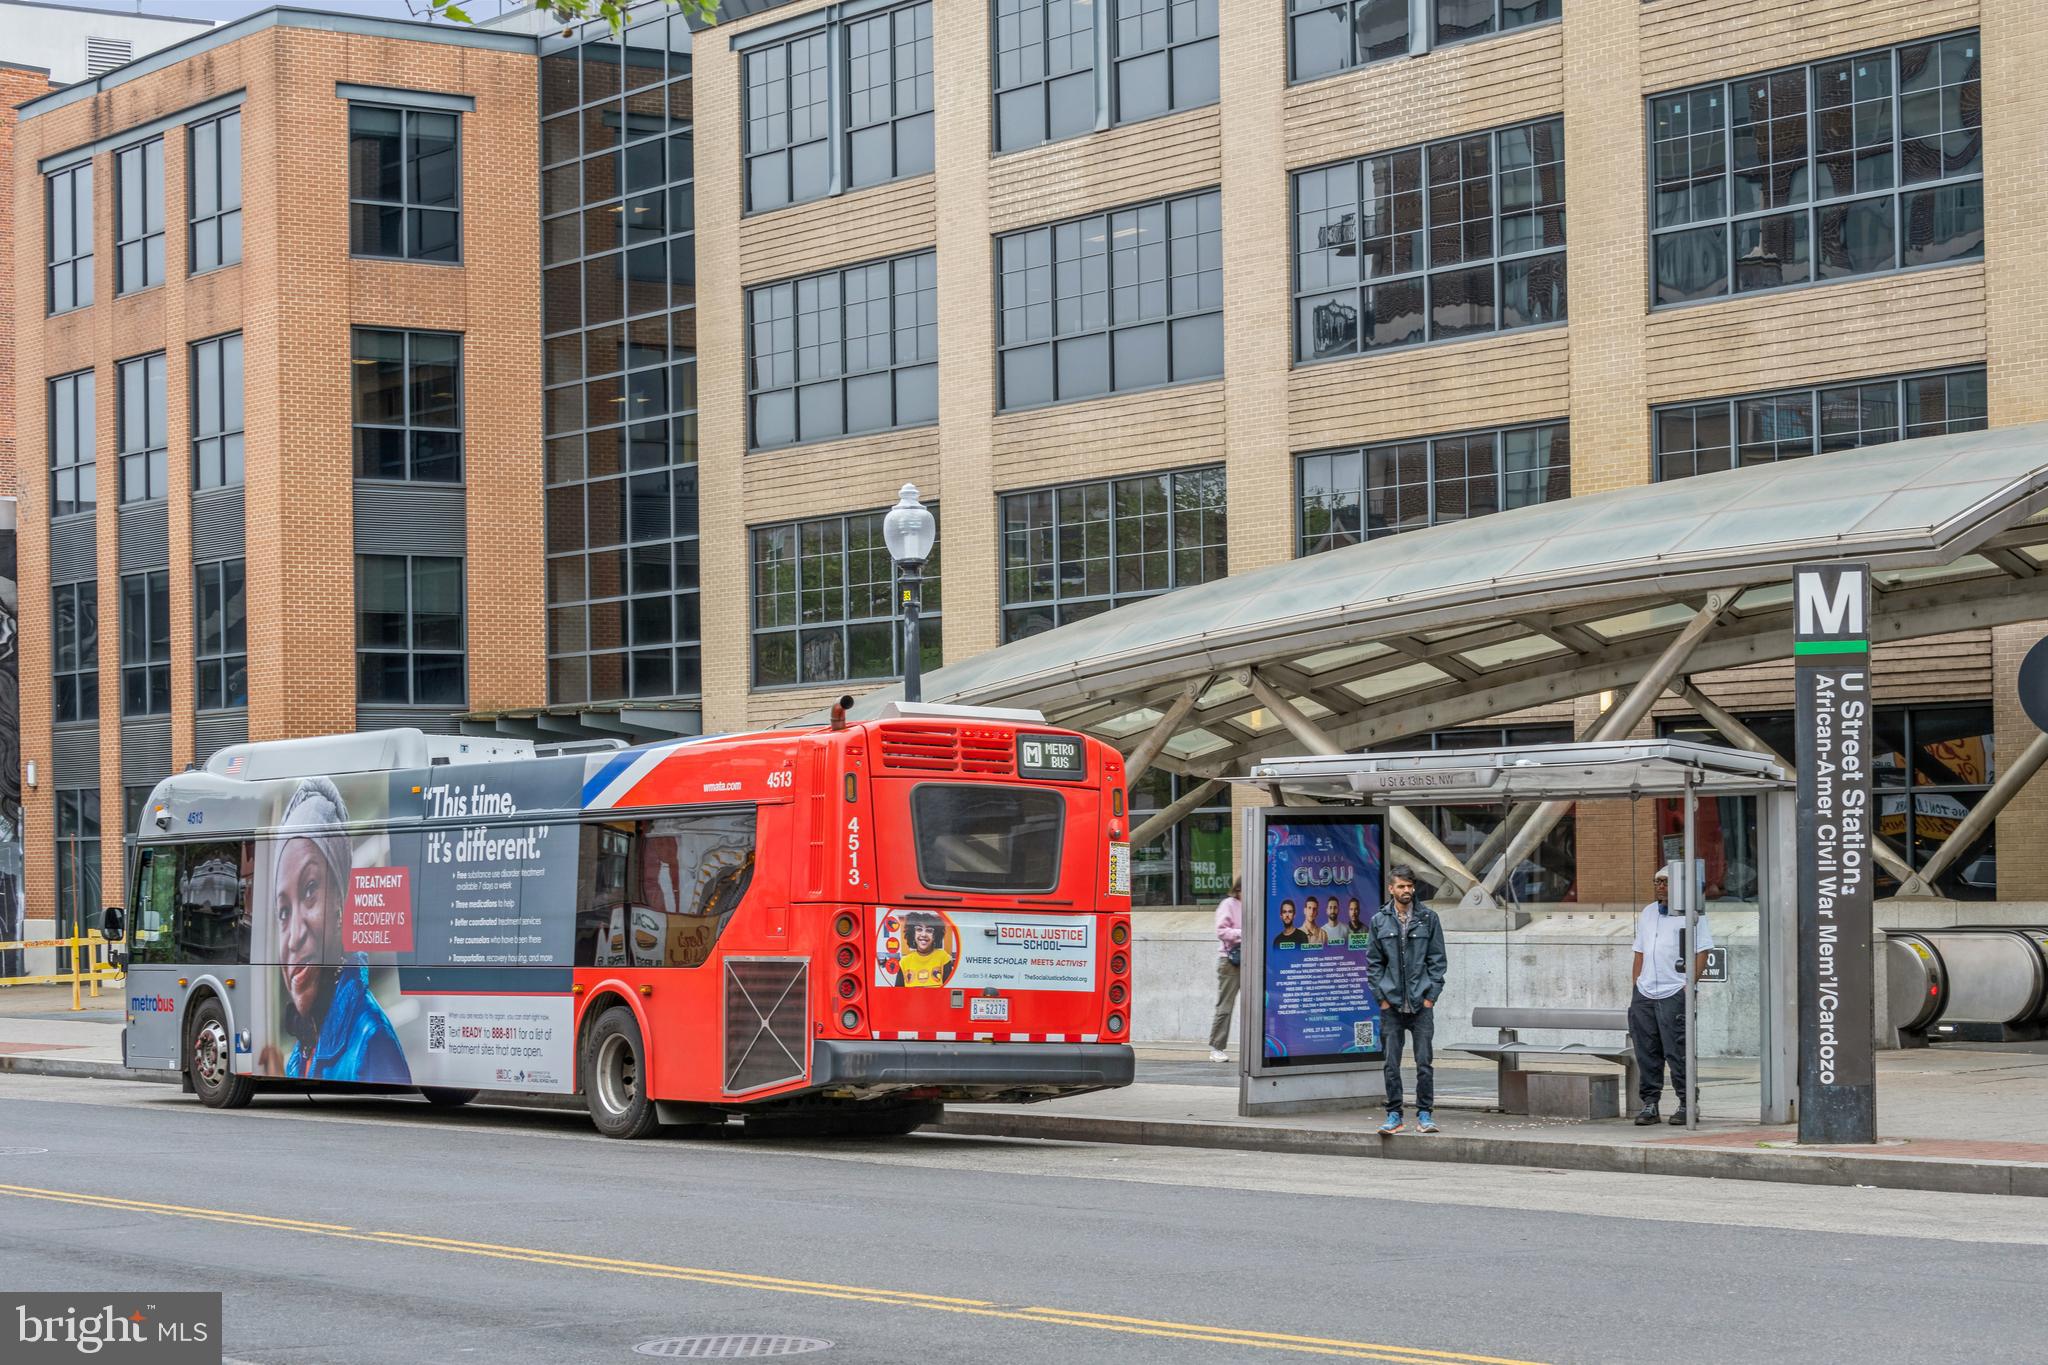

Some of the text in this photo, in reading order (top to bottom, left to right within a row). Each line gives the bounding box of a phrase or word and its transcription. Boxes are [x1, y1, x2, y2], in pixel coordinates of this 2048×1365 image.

[1799, 571, 1862, 634] M
[1841, 672, 1864, 690] U
[1841, 700, 1864, 780] Street
[1025, 744, 1040, 764] M
[1045, 743, 1074, 756] METRO
[1052, 756, 1069, 768] BUS
[766, 771, 792, 788] 4513
[1380, 778, 1386, 786] U
[1388, 776, 1396, 786] St
[1400, 776, 1405, 786] &
[1408, 776, 1424, 786] 13th
[1438, 775, 1454, 785] NW
[704, 782, 742, 792] wmata.com
[472, 784, 516, 818] time,
[188, 812, 203, 824] 4513
[428, 832, 452, 863] it's
[1194, 862, 1216, 874] H&R
[355, 874, 402, 888] TREATMENT
[1194, 876, 1232, 888] BLOCK
[1816, 674, 1838, 1084] African-Amer Civil War Mem'l/Cardozo
[354, 894, 385, 906] WORKS.
[354, 912, 404, 926] RECOVERY IS
[352, 930, 392, 944] POSSIBLE.
[1001, 928, 1083, 940] SOCIAL JUSTICE
[1023, 940, 1061, 950] SCHOOL
[966, 956, 991, 964] WHERE
[994, 957, 1028, 966] SCHOLAR
[1030, 958, 1054, 966] MEETS
[132, 994, 174, 1012] metrobus
[462, 1026, 482, 1038] READY
[484, 1028, 490, 1039] to
[518, 1028, 528, 1040] for
[530, 1031, 534, 1040] a
[535, 1028, 543, 1040] list
[545, 1028, 552, 1040] of
[449, 1044, 480, 1054] treatment
[481, 1044, 494, 1055] sites
[510, 1047, 522, 1056] are
